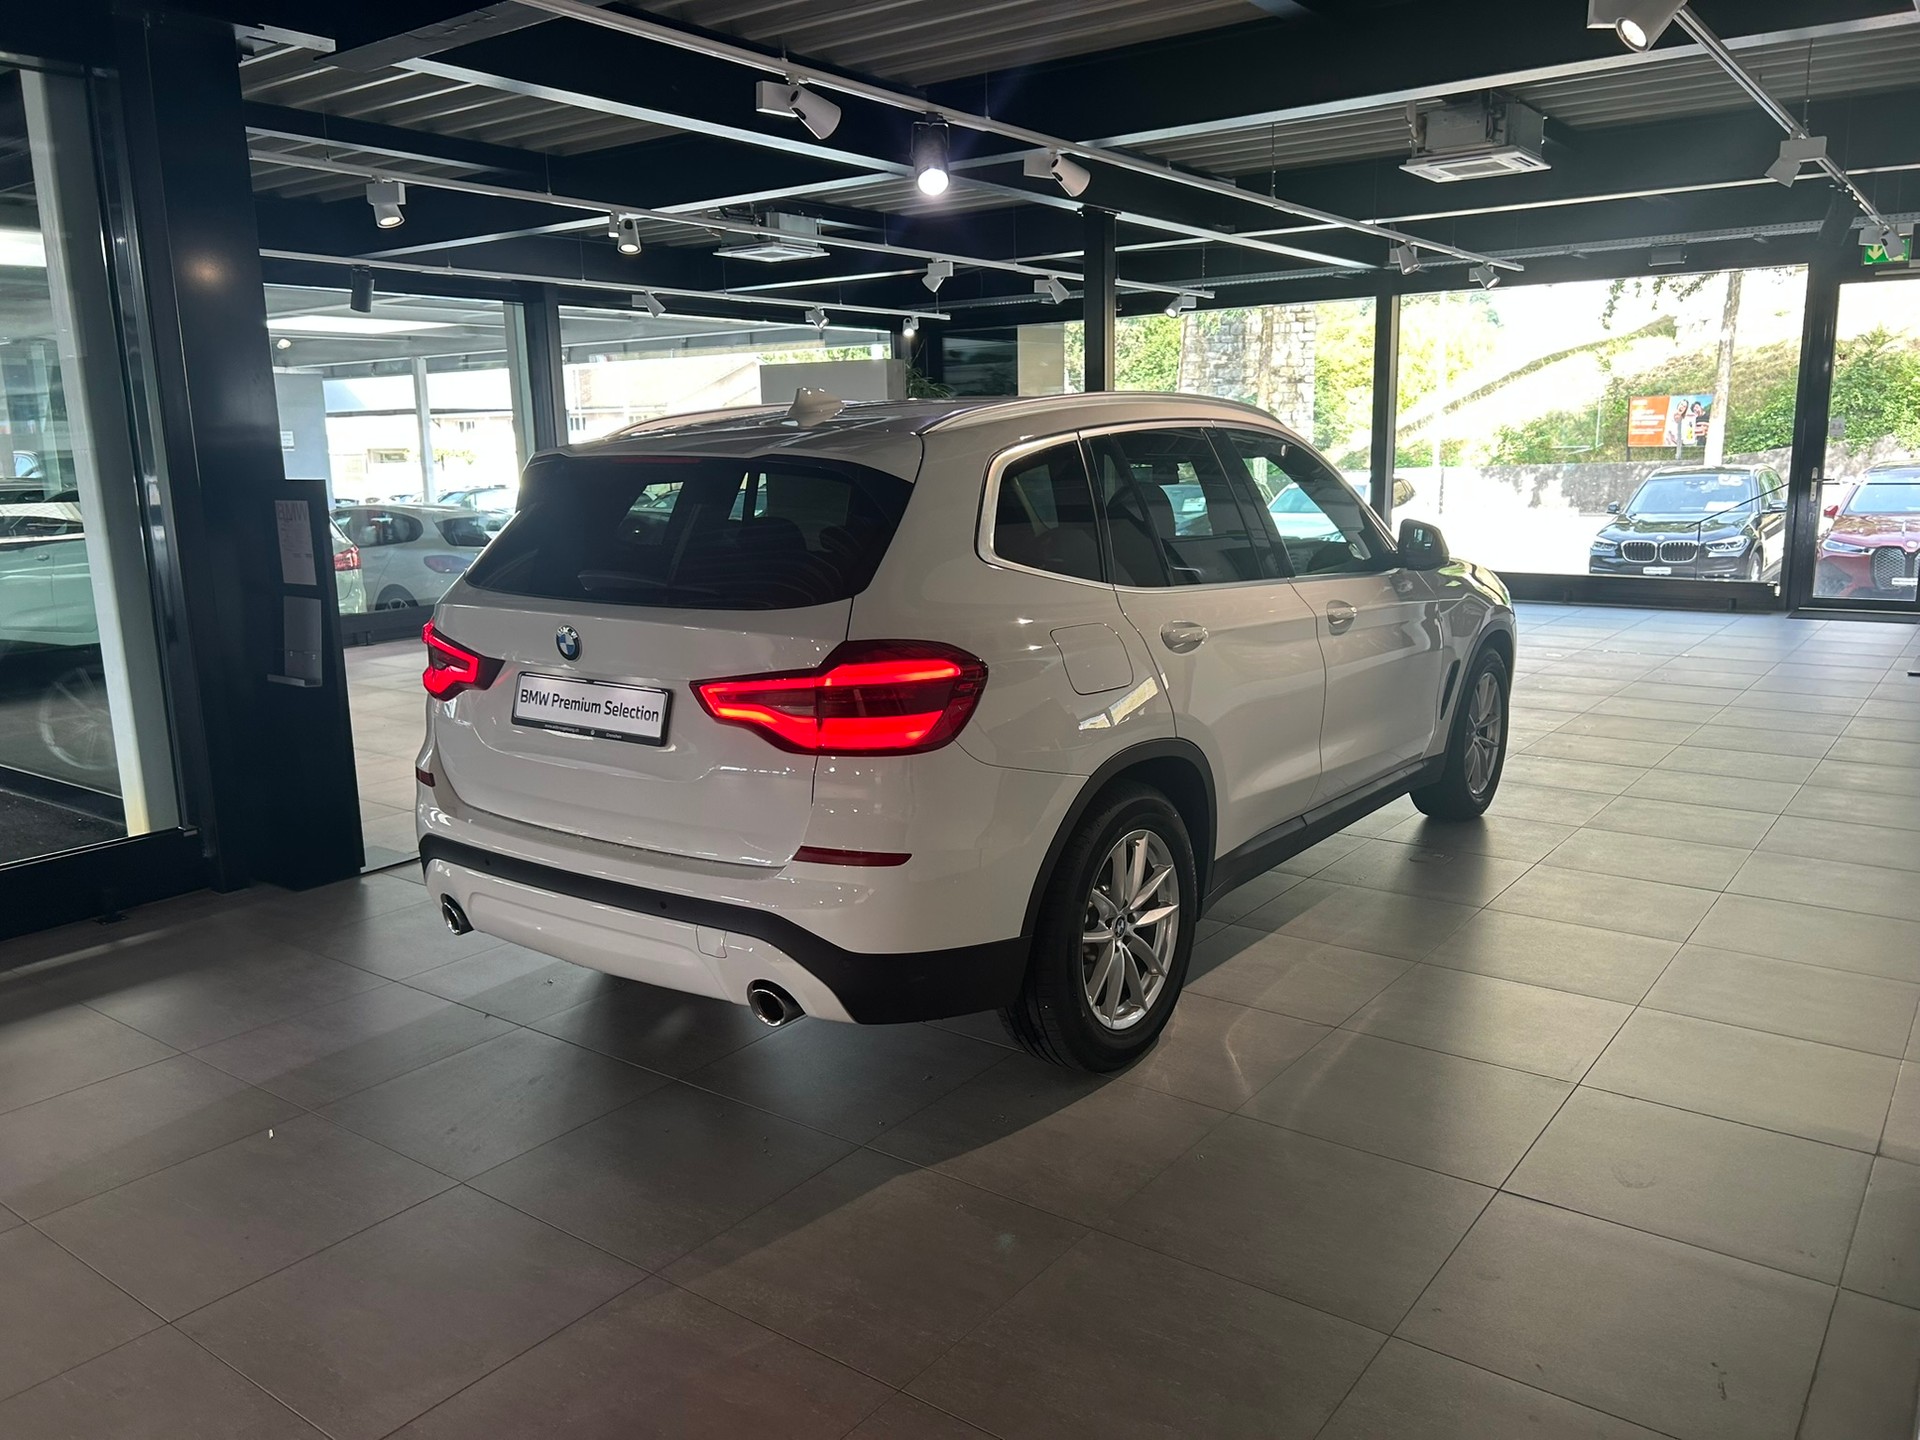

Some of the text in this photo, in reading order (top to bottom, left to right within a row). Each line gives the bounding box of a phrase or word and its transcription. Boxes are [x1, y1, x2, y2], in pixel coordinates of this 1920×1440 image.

[520, 689, 660, 723] BMW Premium Selection
